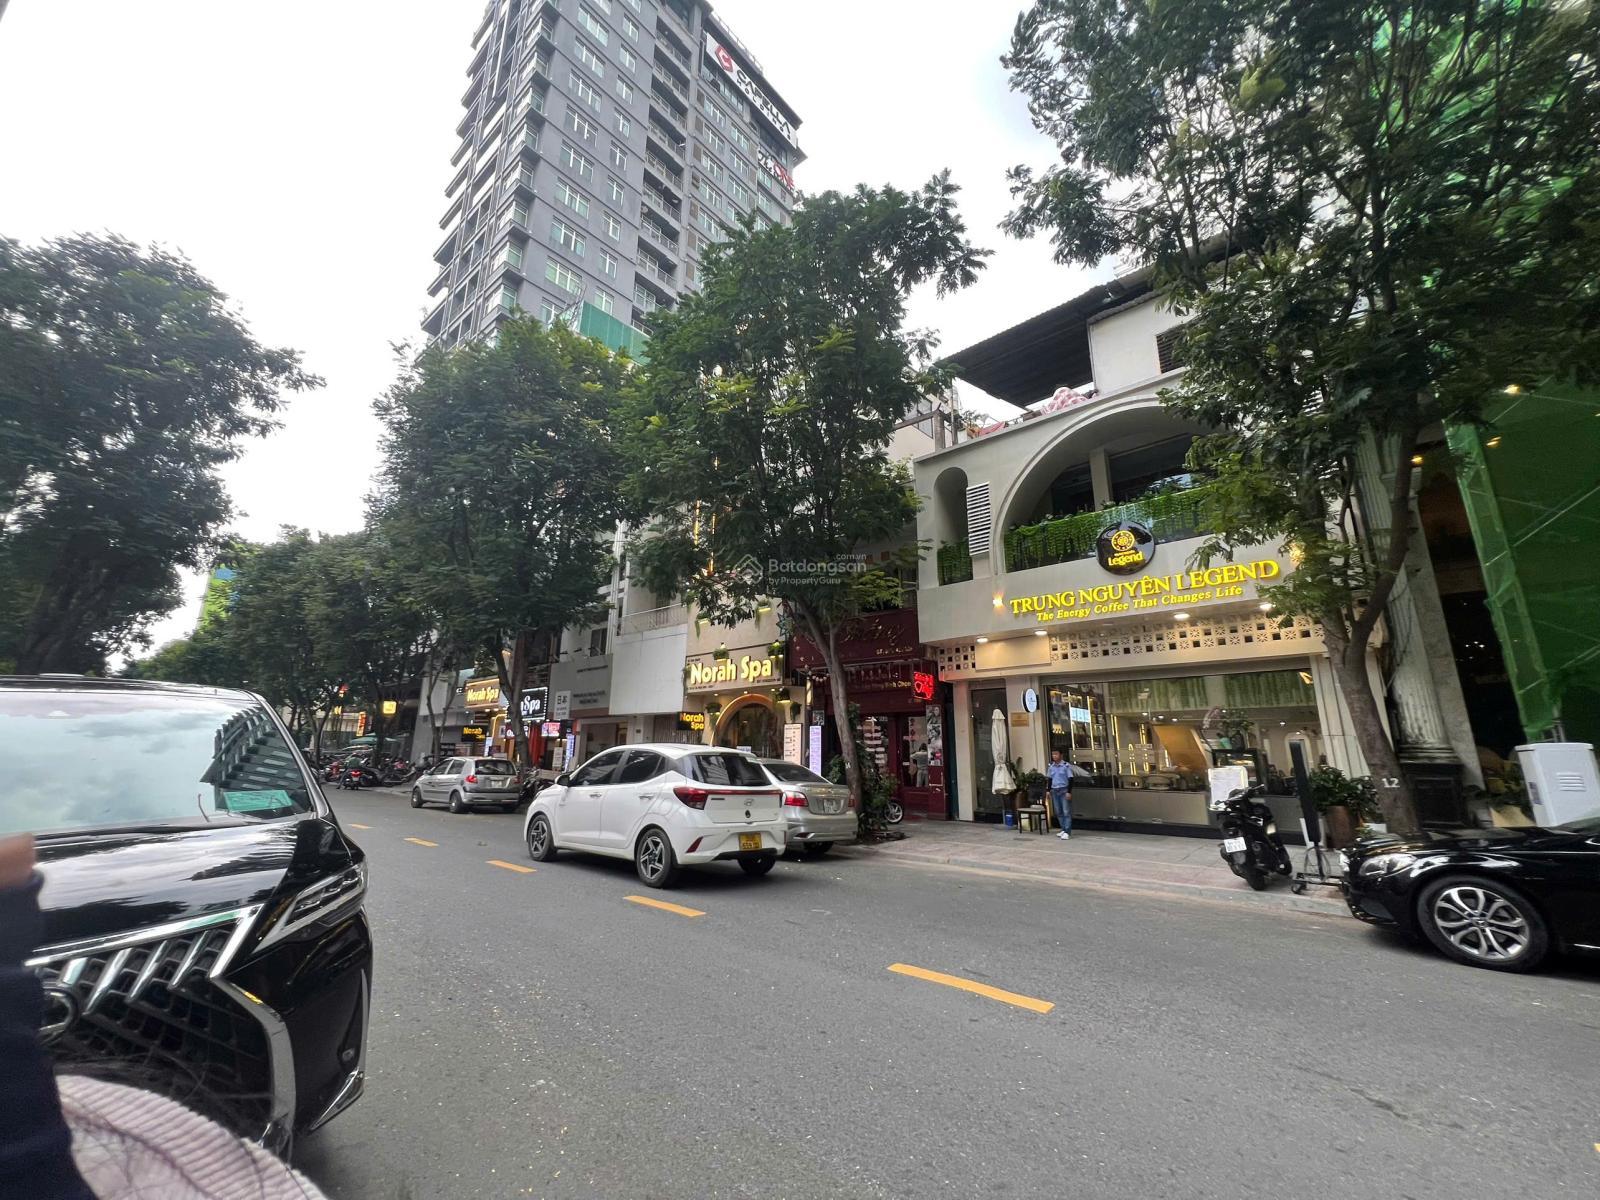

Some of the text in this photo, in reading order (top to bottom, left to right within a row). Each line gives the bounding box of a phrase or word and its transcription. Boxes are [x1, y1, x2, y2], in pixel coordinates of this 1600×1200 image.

[737, 69, 791, 134] CAPELLA
[737, 78, 791, 141] HOLDINGS
[1107, 550, 1144, 566] Legend
[1010, 560, 1279, 614] TRUNG NGUYÊN LEGEND
[1037, 586, 1243, 621] The Energy Coffee That Changes Life
[690, 656, 773, 685] Norah Spa
[524, 696, 541, 714] Spa
[691, 721, 705, 730] Spa
[1382, 777, 1401, 788] 12
